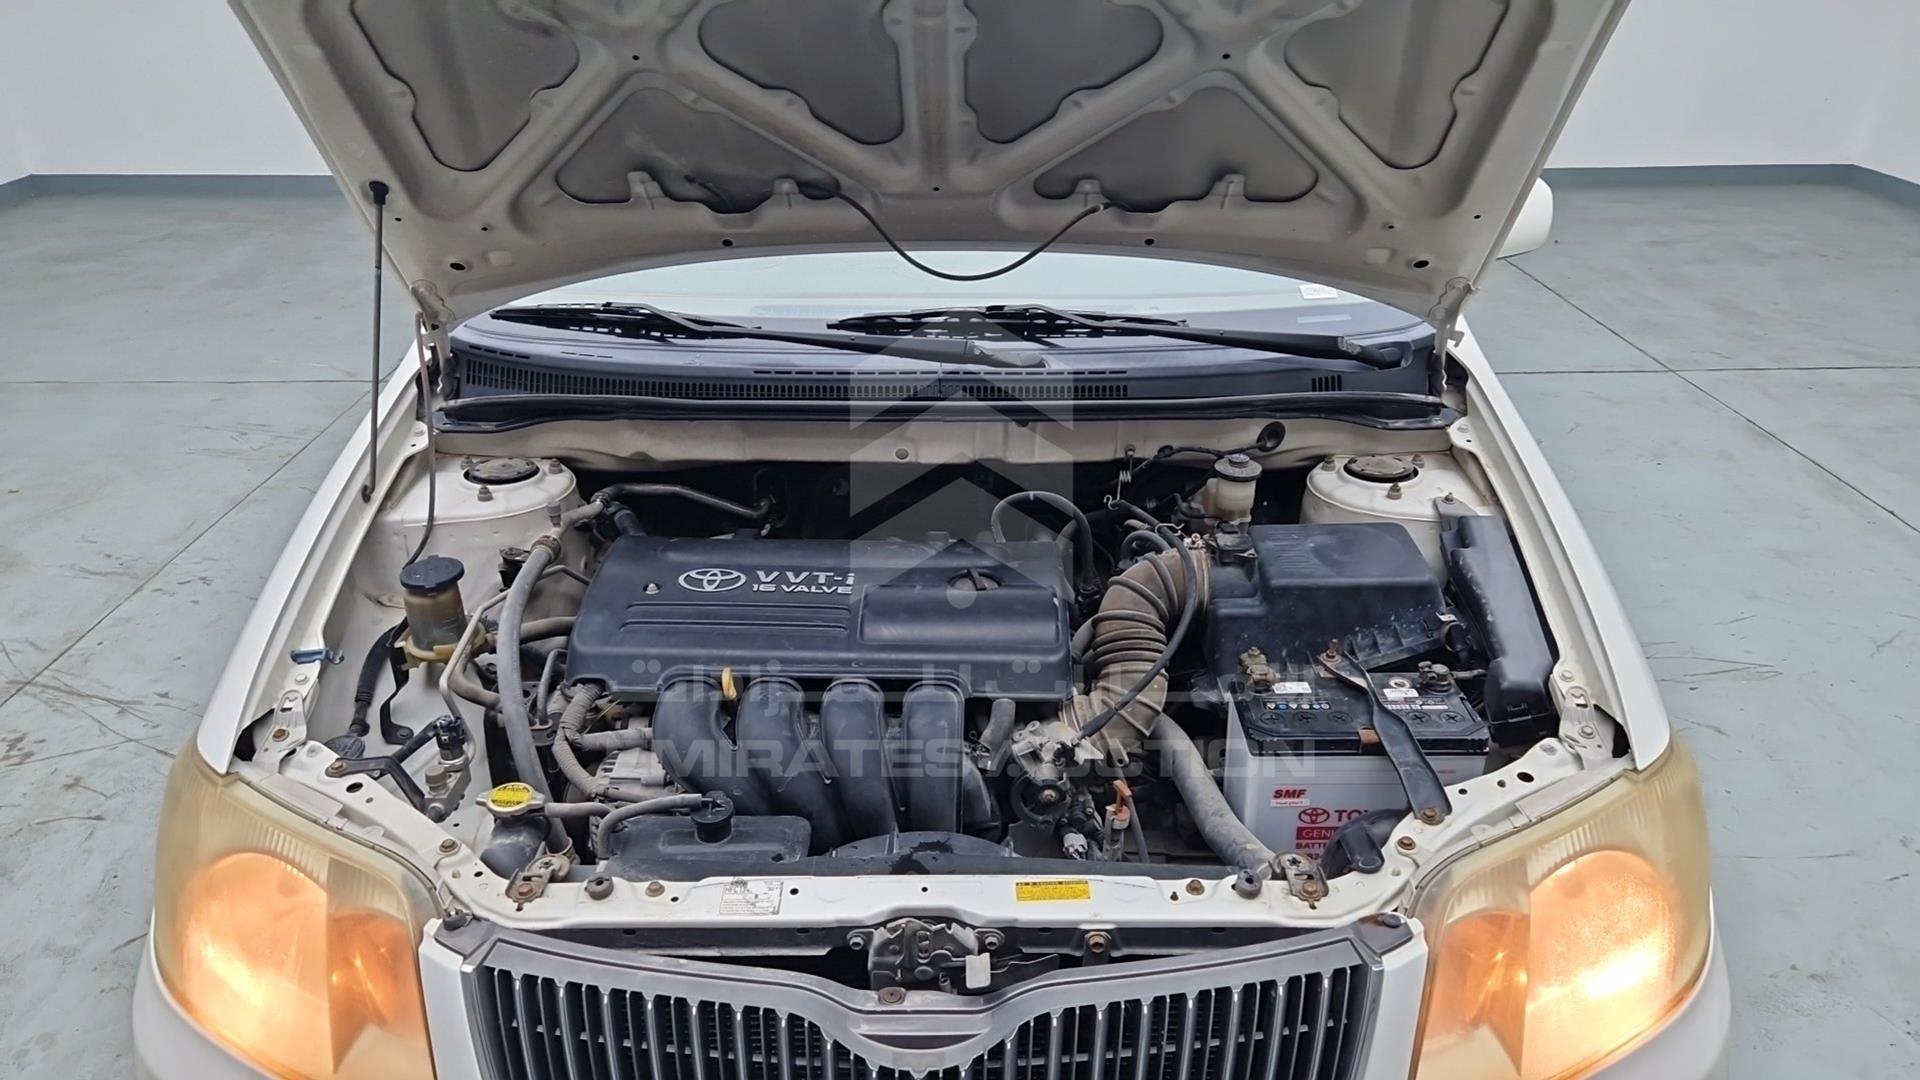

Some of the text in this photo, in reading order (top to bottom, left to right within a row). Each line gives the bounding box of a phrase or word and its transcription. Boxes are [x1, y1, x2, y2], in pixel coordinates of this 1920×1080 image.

[756, 570, 856, 585] VVT-i
[752, 583, 853, 594] 16 VALVE
[1272, 788, 1308, 799] SMF
